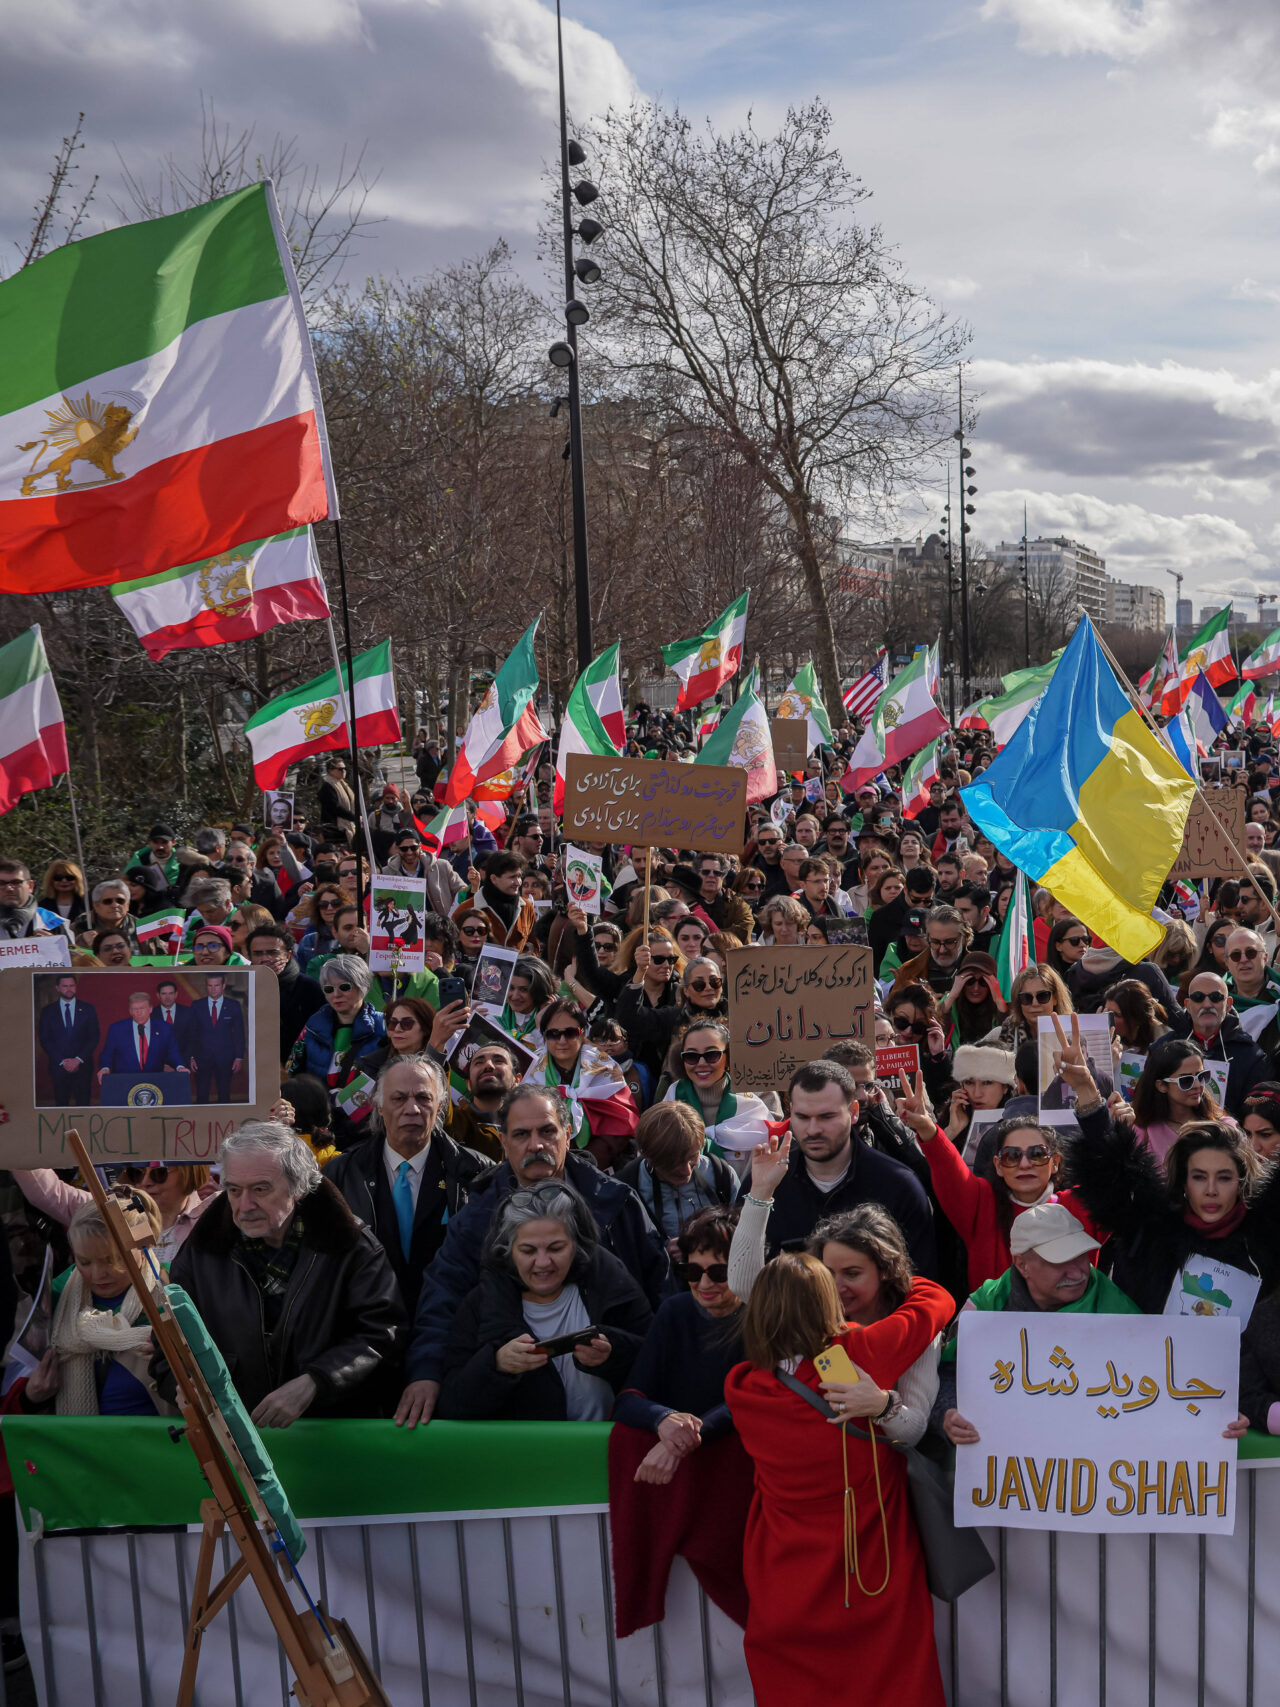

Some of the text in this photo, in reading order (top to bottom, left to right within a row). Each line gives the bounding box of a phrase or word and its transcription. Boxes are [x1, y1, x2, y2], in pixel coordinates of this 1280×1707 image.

[576, 768, 623, 792] آزادی
[613, 774, 641, 797] برای
[573, 800, 618, 830] آبادی
[607, 809, 640, 831] برای
[827, 1000, 870, 1040] آب
[882, 1051, 910, 1060] LIBERTÉ
[887, 1060, 914, 1069] PAHLAVI
[151, 1115, 261, 1158] TRUM
[1213, 1266, 1231, 1277] IRAN
[989, 1327, 1227, 1419] جاوید شاه
[971, 1456, 1229, 1517] JAVID SHAH
